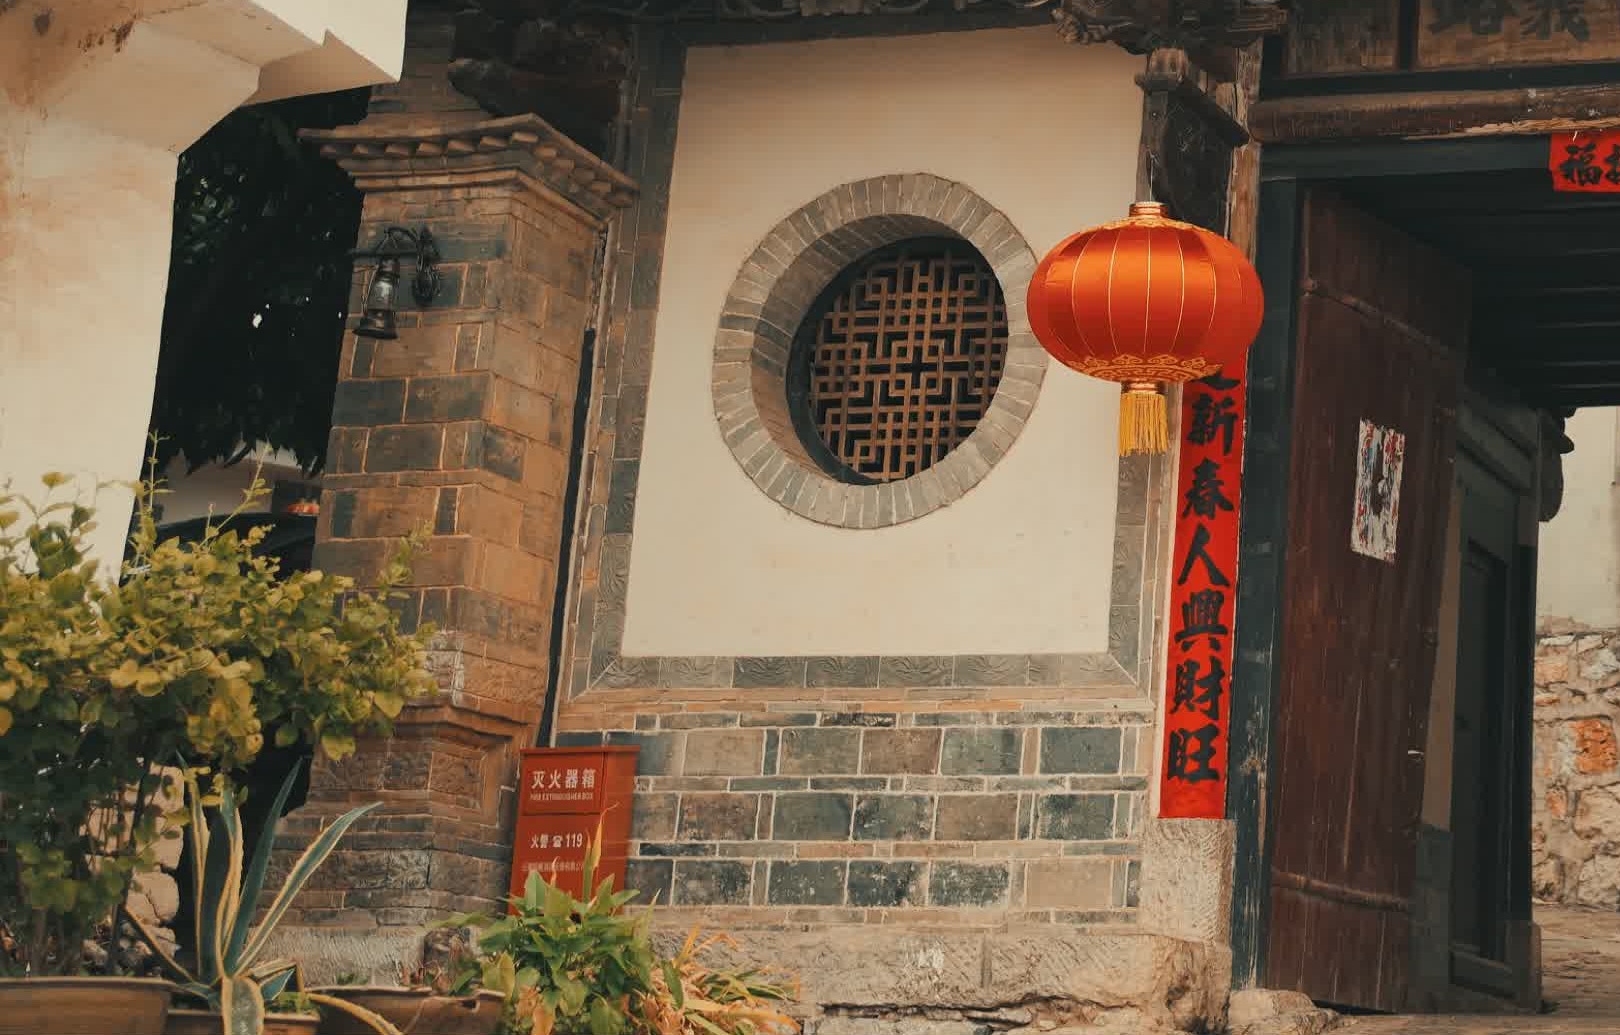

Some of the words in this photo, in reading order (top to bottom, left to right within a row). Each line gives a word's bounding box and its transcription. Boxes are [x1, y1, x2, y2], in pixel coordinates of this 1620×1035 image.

[1167, 363, 1241, 783] 新春人興財旺
[531, 768, 596, 789] 灭火器箱
[566, 832, 583, 847] 119
